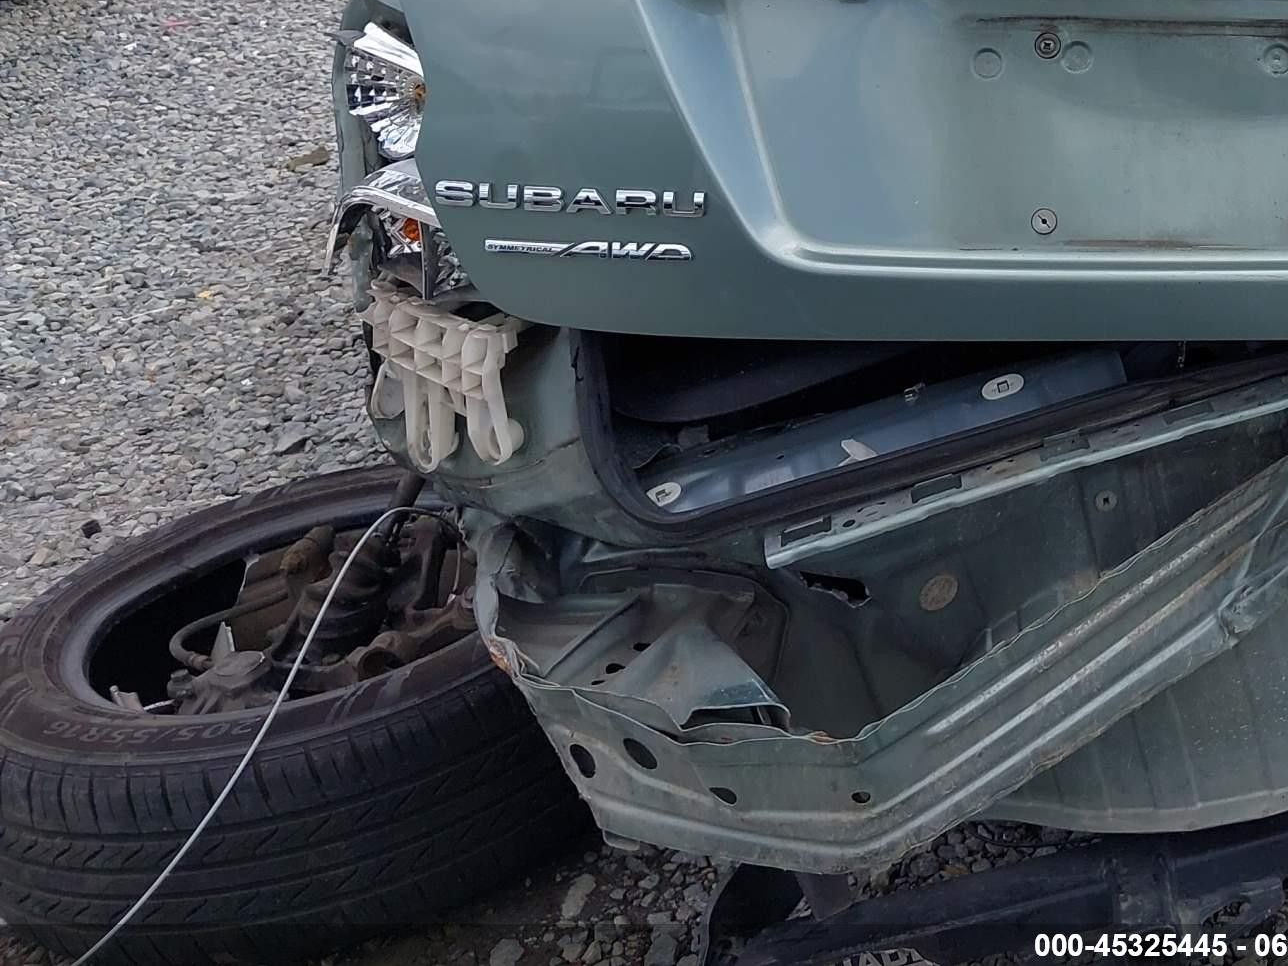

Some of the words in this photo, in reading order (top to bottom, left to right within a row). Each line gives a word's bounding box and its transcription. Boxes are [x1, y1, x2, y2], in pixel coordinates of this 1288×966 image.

[435, 180, 706, 218] SUBARU
[487, 243, 553, 253] SYMMETRICAL
[559, 240, 695, 261] AWD
[43, 716, 262, 745] 205/55R16
